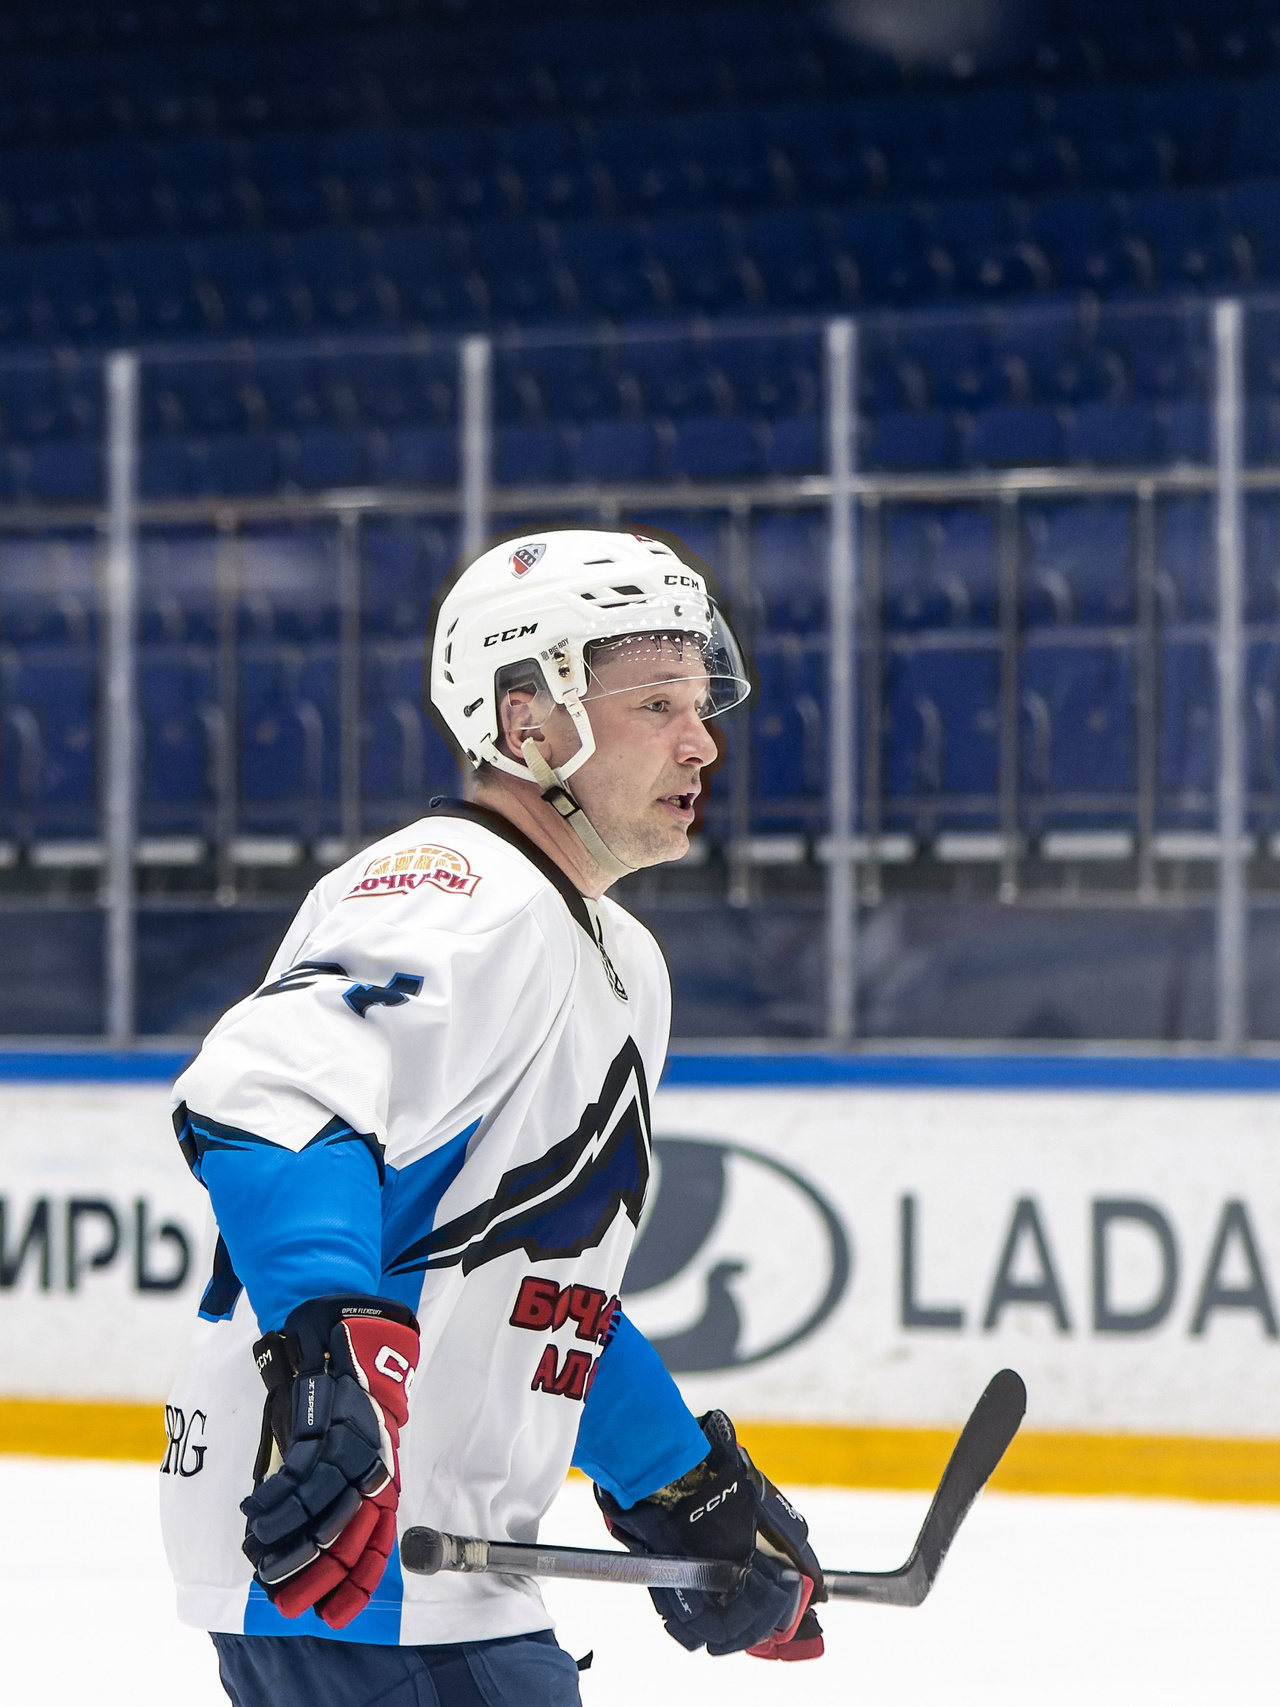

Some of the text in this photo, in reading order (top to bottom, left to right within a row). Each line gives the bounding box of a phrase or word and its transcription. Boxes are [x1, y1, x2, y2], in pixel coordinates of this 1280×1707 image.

[663, 574, 700, 591] CCM
[483, 622, 539, 648] CCM
[899, 1192, 1280, 1339] LADA
[341, 1307, 358, 1315] OPEN
[307, 1378, 315, 1427] JETSPEED
[689, 1481, 738, 1523] CCM
